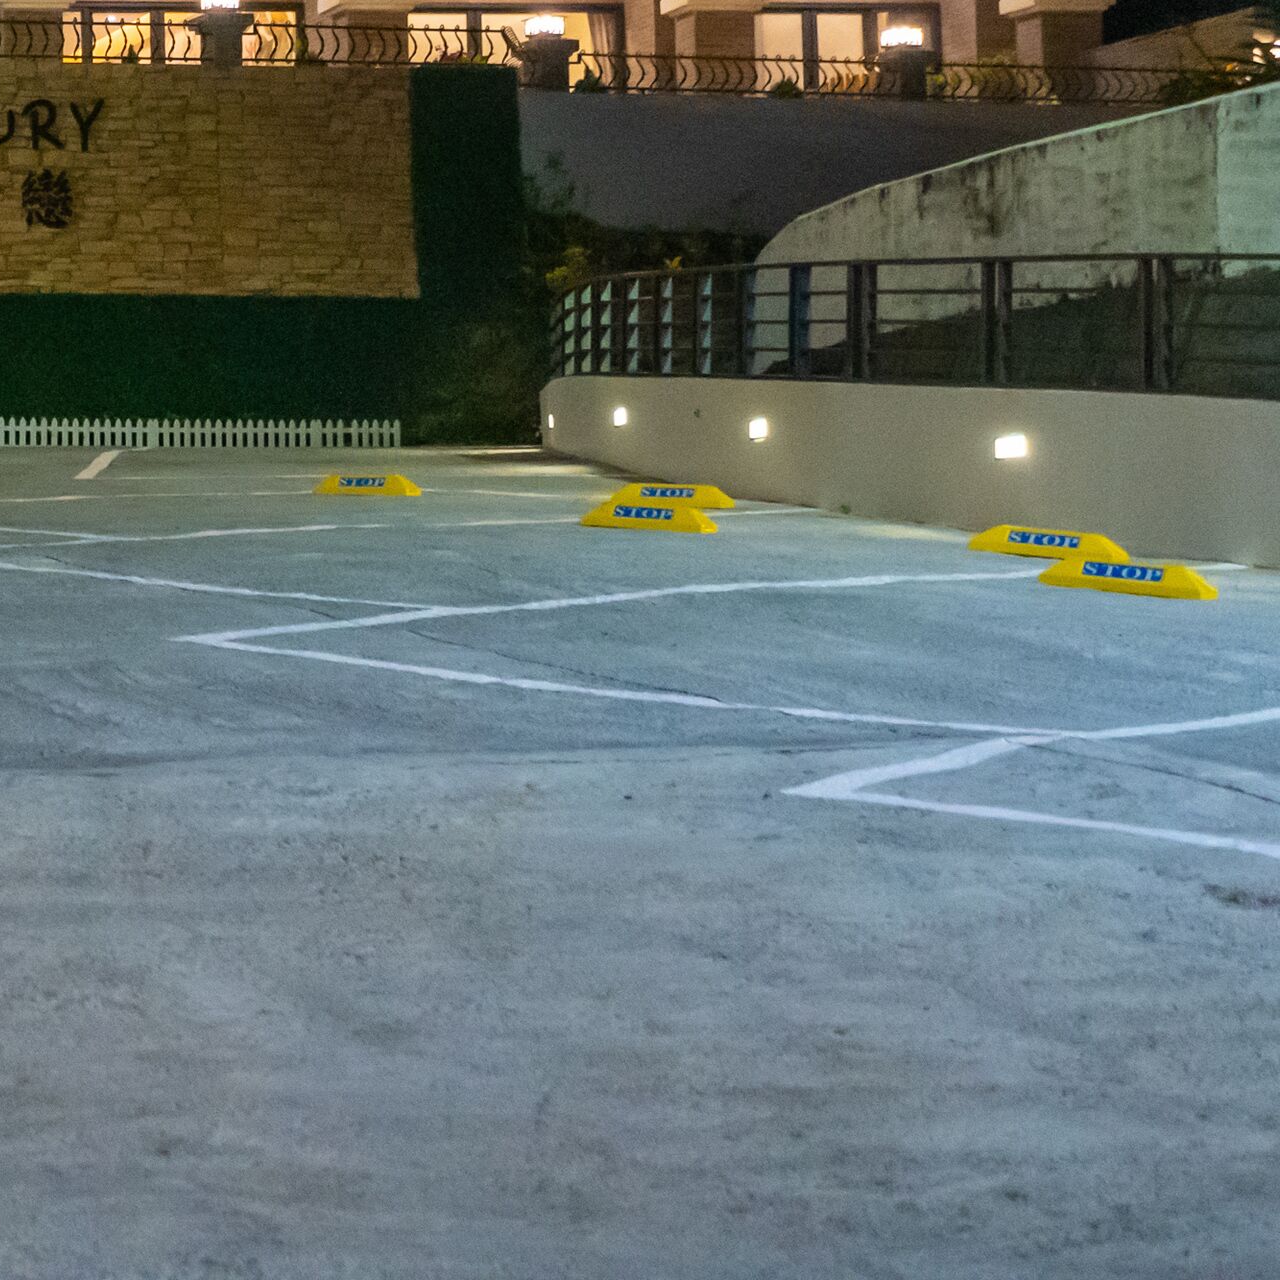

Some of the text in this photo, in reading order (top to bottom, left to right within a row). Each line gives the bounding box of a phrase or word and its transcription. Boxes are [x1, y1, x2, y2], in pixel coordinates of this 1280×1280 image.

[339, 477, 385, 487] STOP
[641, 487, 694, 498] STOP
[613, 505, 673, 519] STOP
[1009, 531, 1079, 548] STOP
[1083, 562, 1163, 581] STOP
